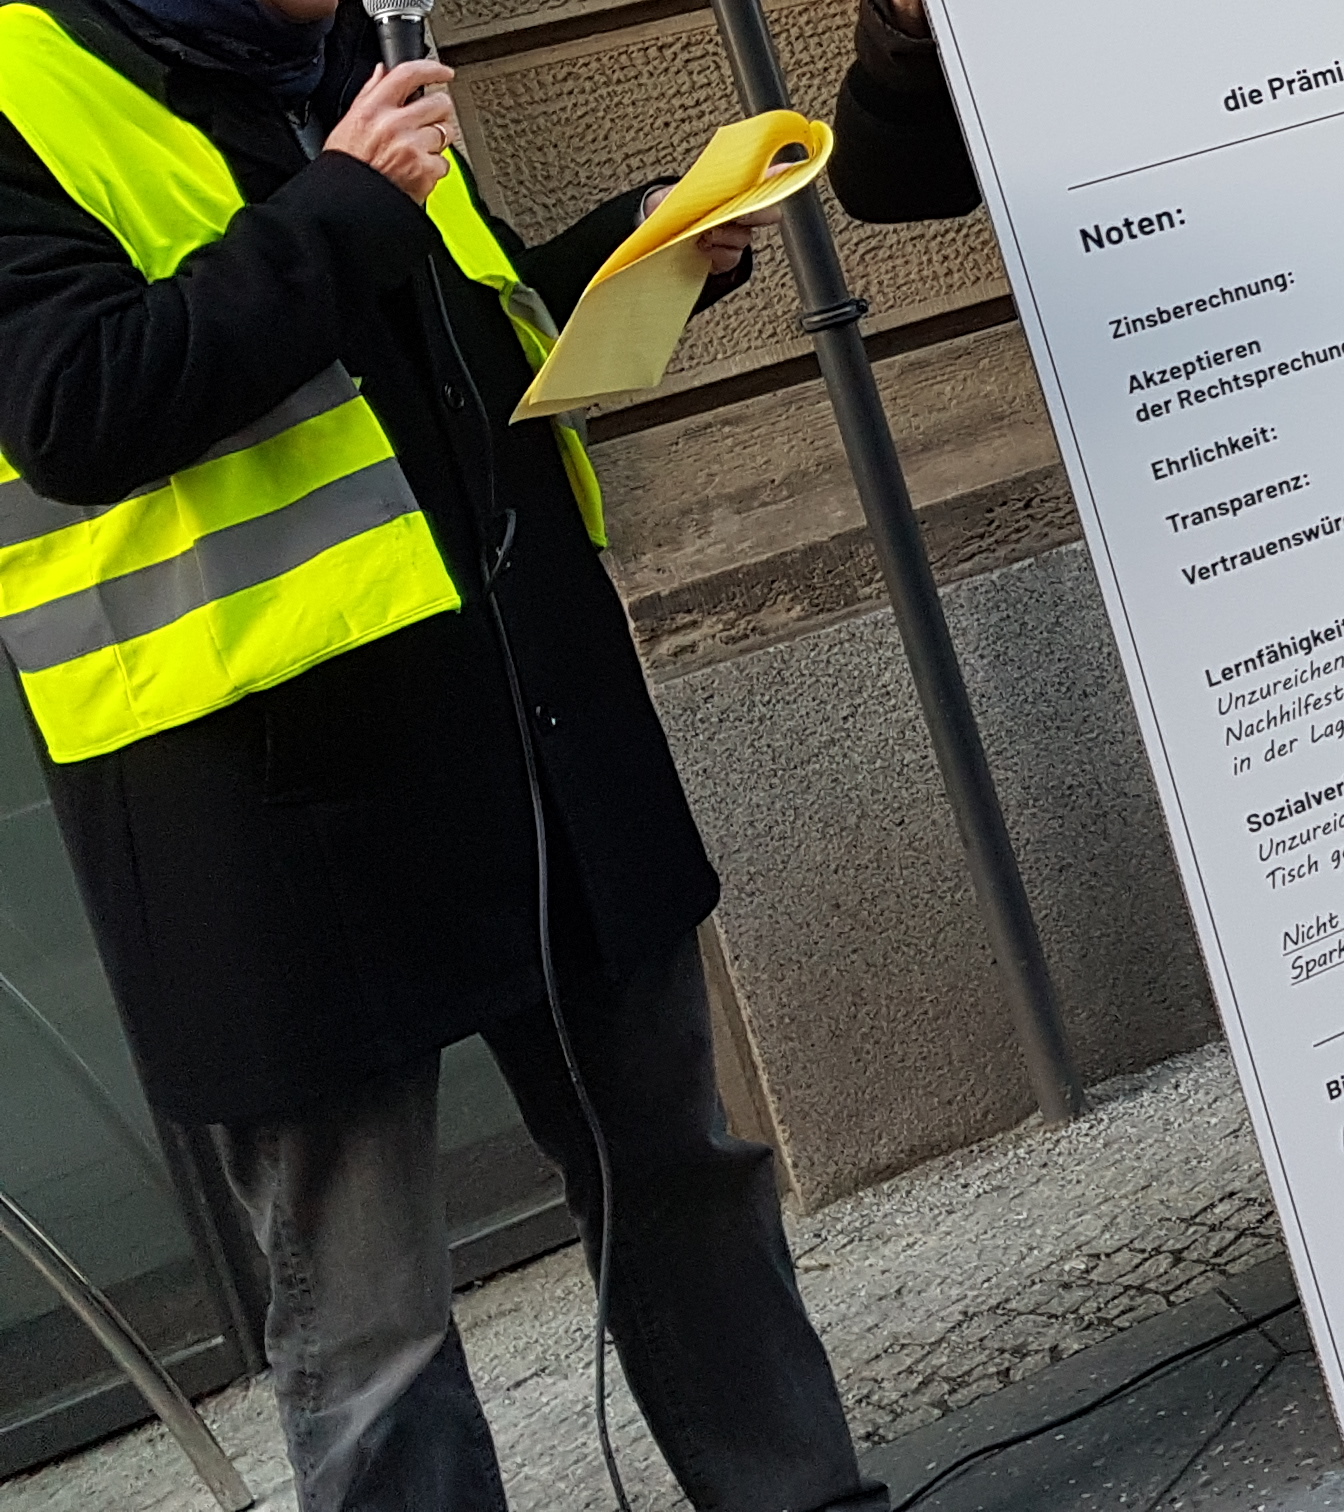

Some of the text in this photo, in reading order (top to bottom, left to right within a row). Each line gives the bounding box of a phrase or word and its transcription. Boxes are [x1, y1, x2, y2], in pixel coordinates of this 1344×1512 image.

[1222, 85, 1264, 112] die
[1078, 207, 1186, 254] Noten:
[1107, 270, 1295, 340] Zinsberechnung:
[1128, 339, 1262, 395] Akzeptieren
[1135, 397, 1173, 423] der
[1149, 426, 1278, 481] Ehrlichkeit:
[1164, 472, 1311, 533] Transparenz:
[1232, 755, 1252, 776] in
[1263, 737, 1299, 763] der
